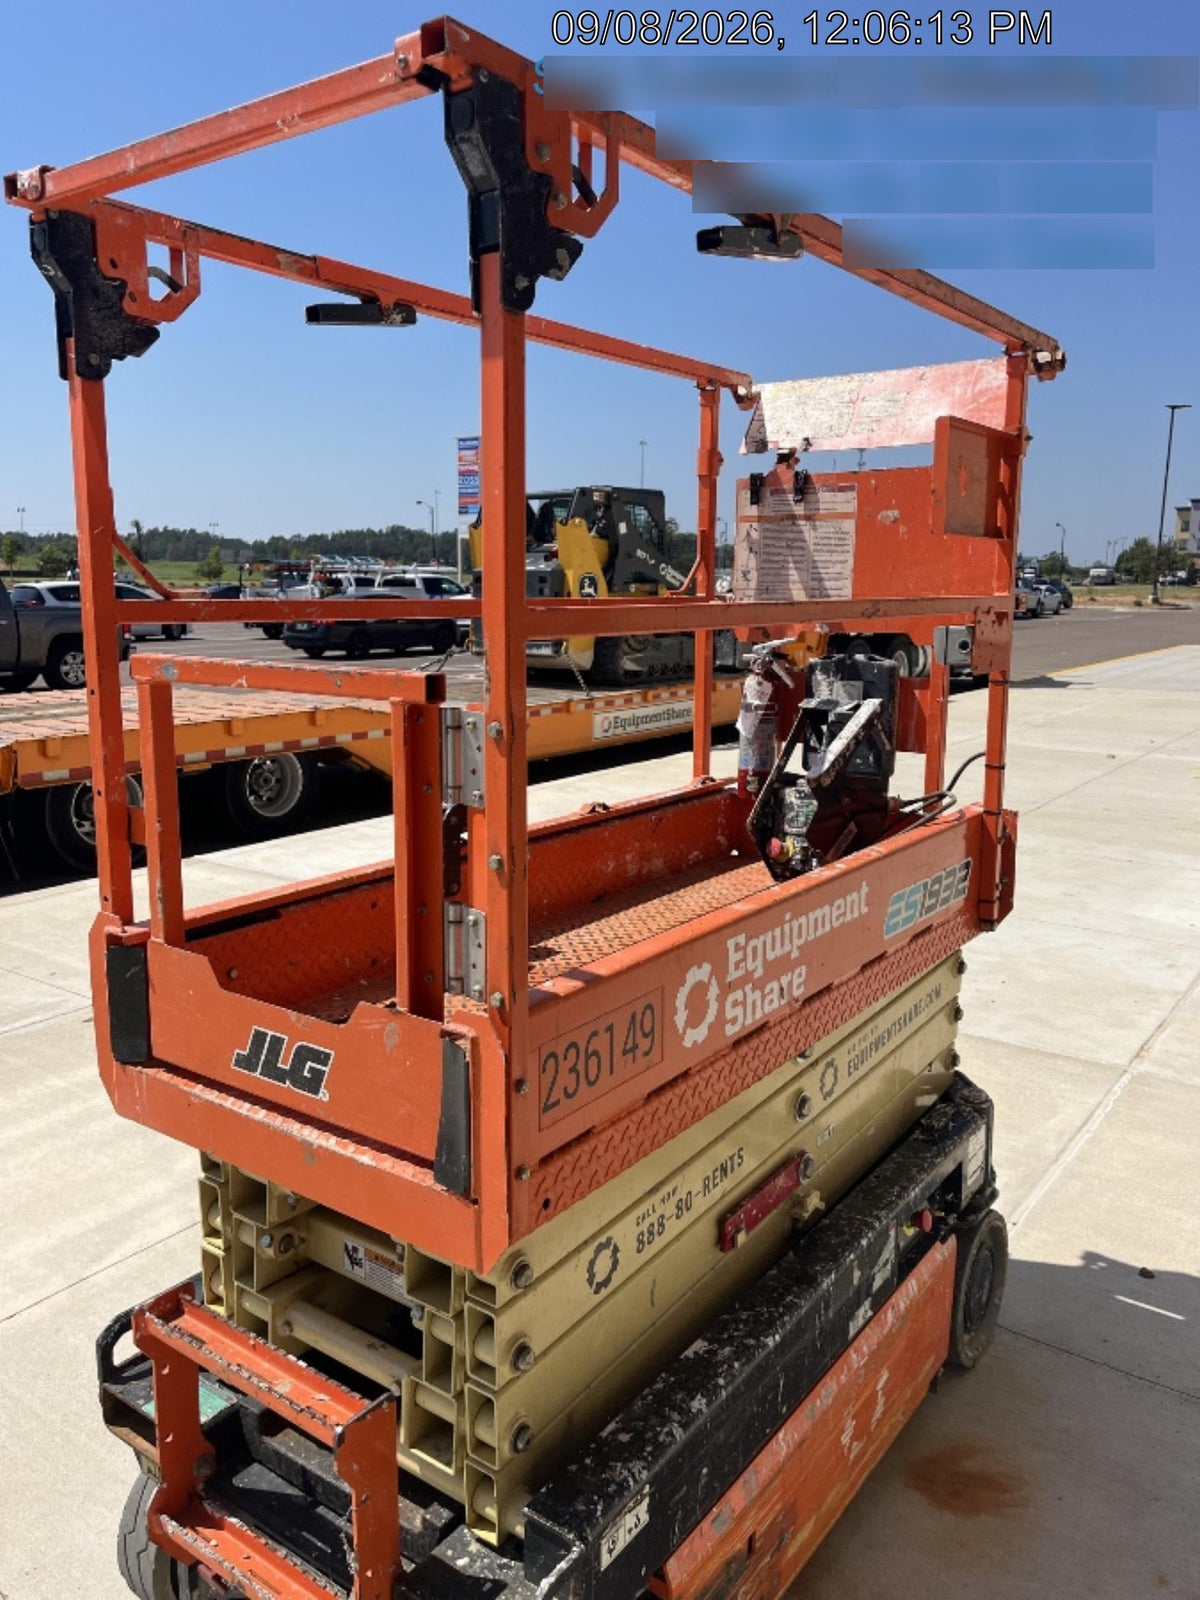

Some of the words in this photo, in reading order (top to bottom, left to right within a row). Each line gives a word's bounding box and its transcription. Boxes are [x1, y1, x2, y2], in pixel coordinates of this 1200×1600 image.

[613, 707, 692, 731] EquipmentShare
[726, 881, 869, 983] Equipment
[884, 858, 972, 939] ES1932
[724, 965, 806, 1037] Share
[231, 1026, 334, 1100] JLG
[541, 1002, 656, 1113] 236149
[636, 1146, 744, 1254] 888-80-RENTS
[636, 1203, 656, 1228] CALL
